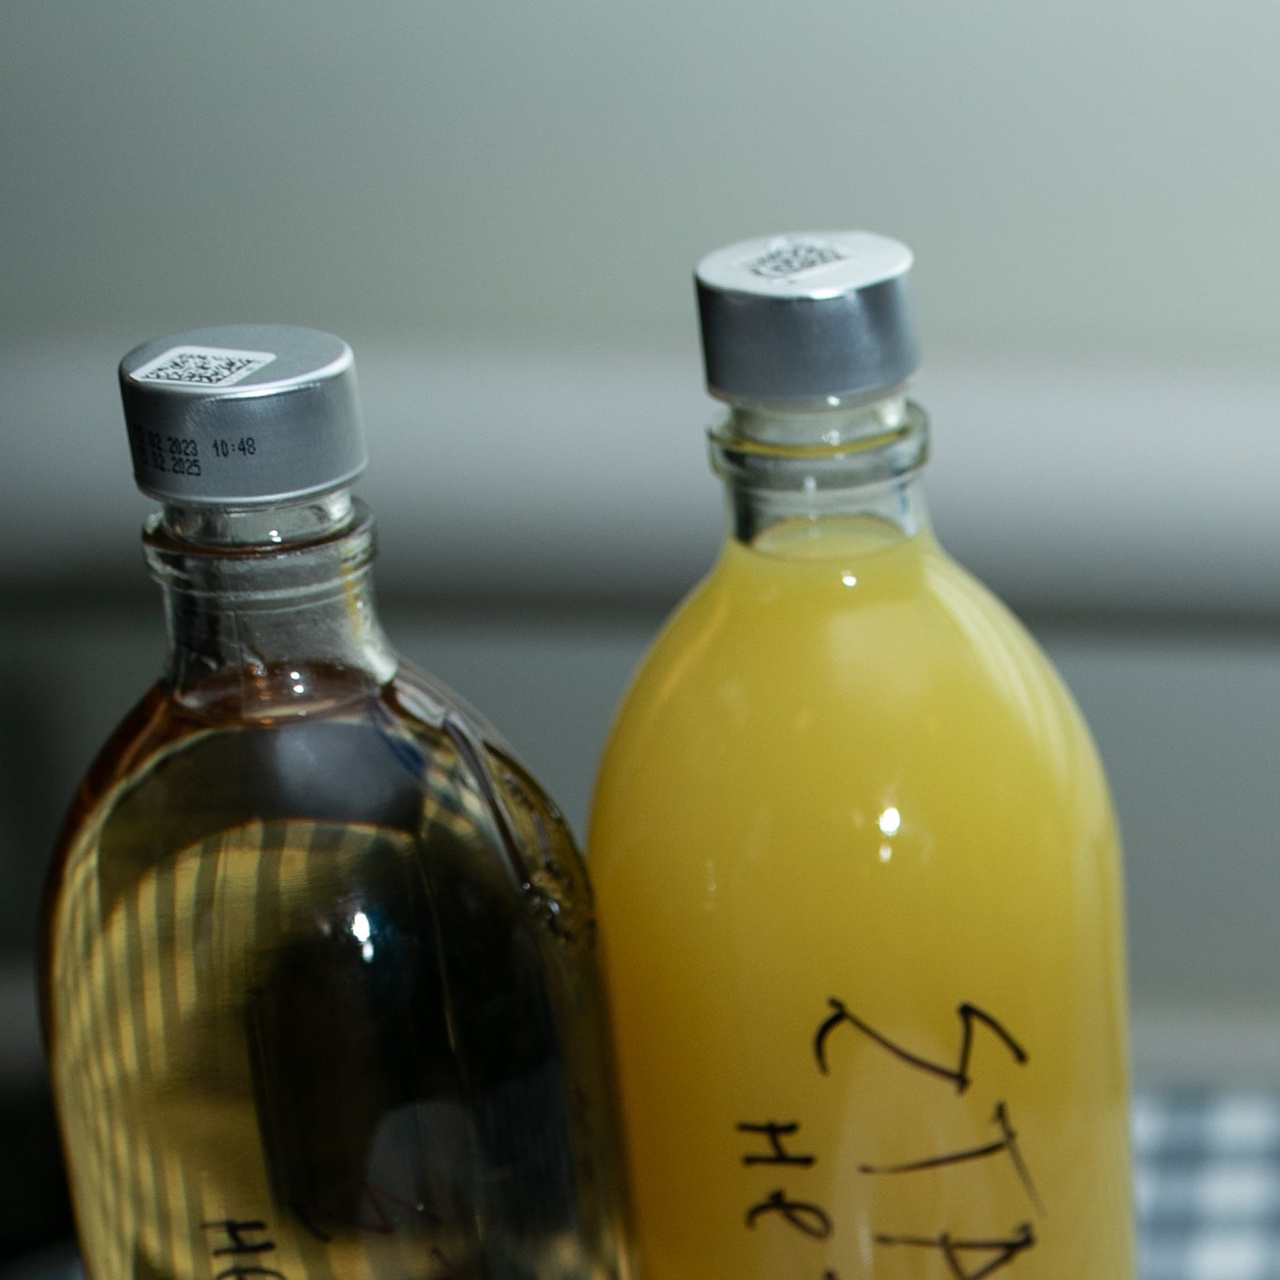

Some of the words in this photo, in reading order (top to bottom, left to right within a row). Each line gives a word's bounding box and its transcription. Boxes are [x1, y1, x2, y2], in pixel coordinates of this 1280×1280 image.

[132, 423, 199, 457] .02.2023
[211, 435, 257, 459] 10:48
[137, 446, 202, 477] .02.2025
